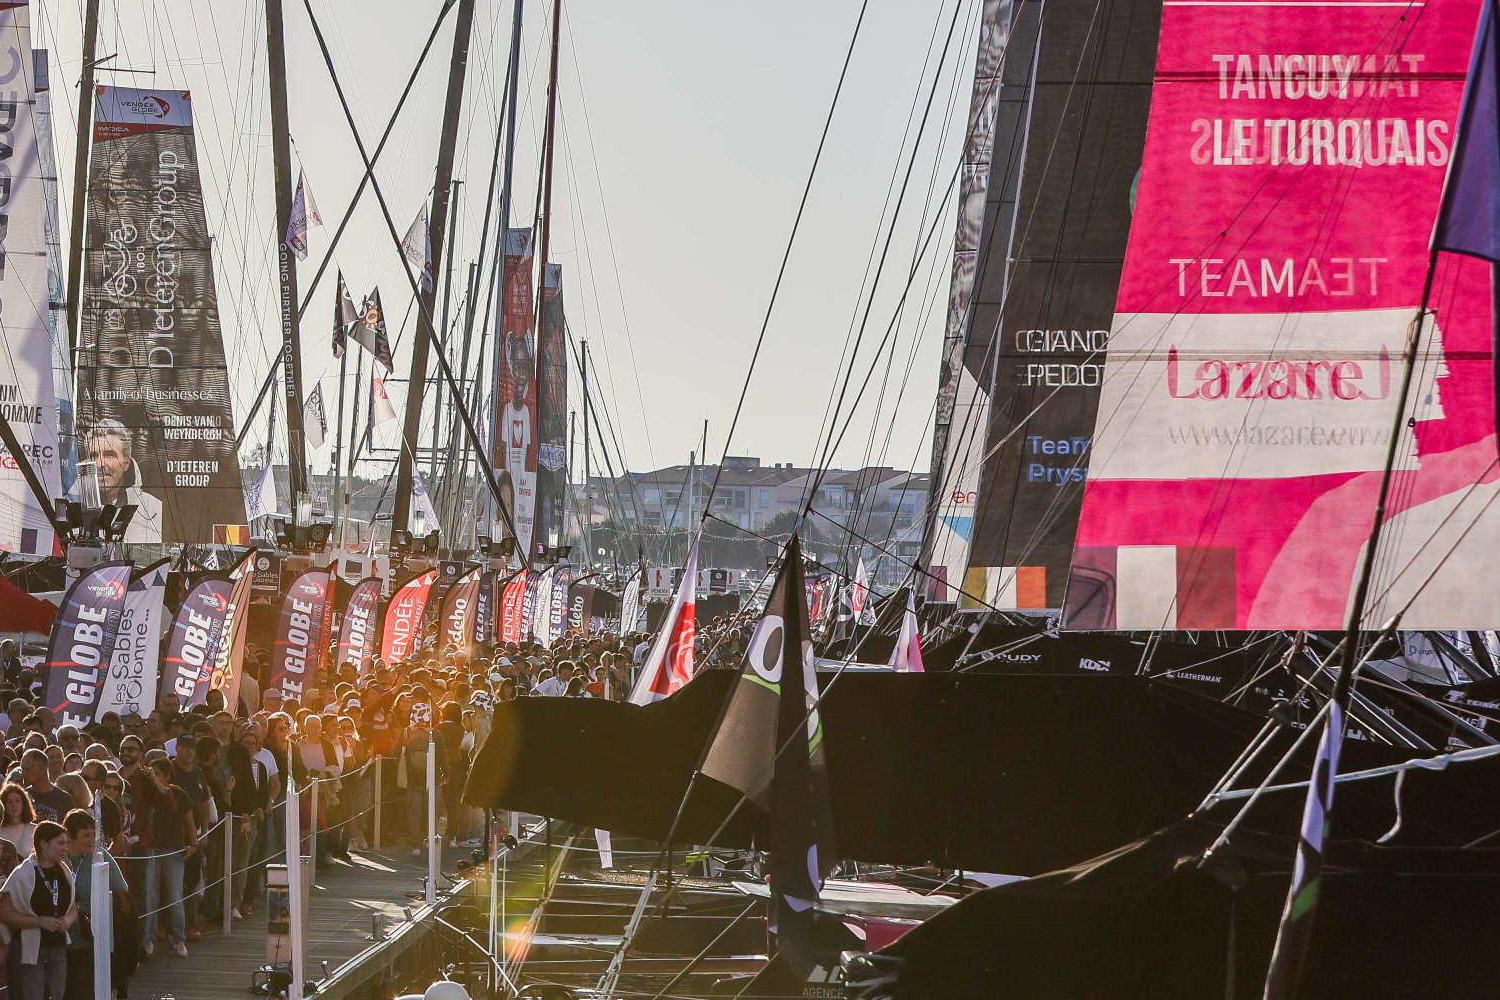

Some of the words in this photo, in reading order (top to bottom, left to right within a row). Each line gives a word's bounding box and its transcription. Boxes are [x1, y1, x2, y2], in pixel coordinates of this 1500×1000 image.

[1212, 54, 1357, 100] TANGUY
[1213, 120, 1253, 165] LE
[1270, 120, 1448, 168] TURQUAIS
[282, 285, 292, 335] FURTHER
[284, 340, 295, 398] TOGETHER
[145, 387, 213, 401] businesses
[175, 474, 210, 487] GROUP
[66, 604, 108, 704] GLOBE
[112, 608, 134, 680] Sables
[174, 608, 213, 697] GLOBE
[284, 599, 313, 674] GLOBE
[111, 684, 126, 706] les
[1176, 671, 1223, 684] LEATHERMAN
